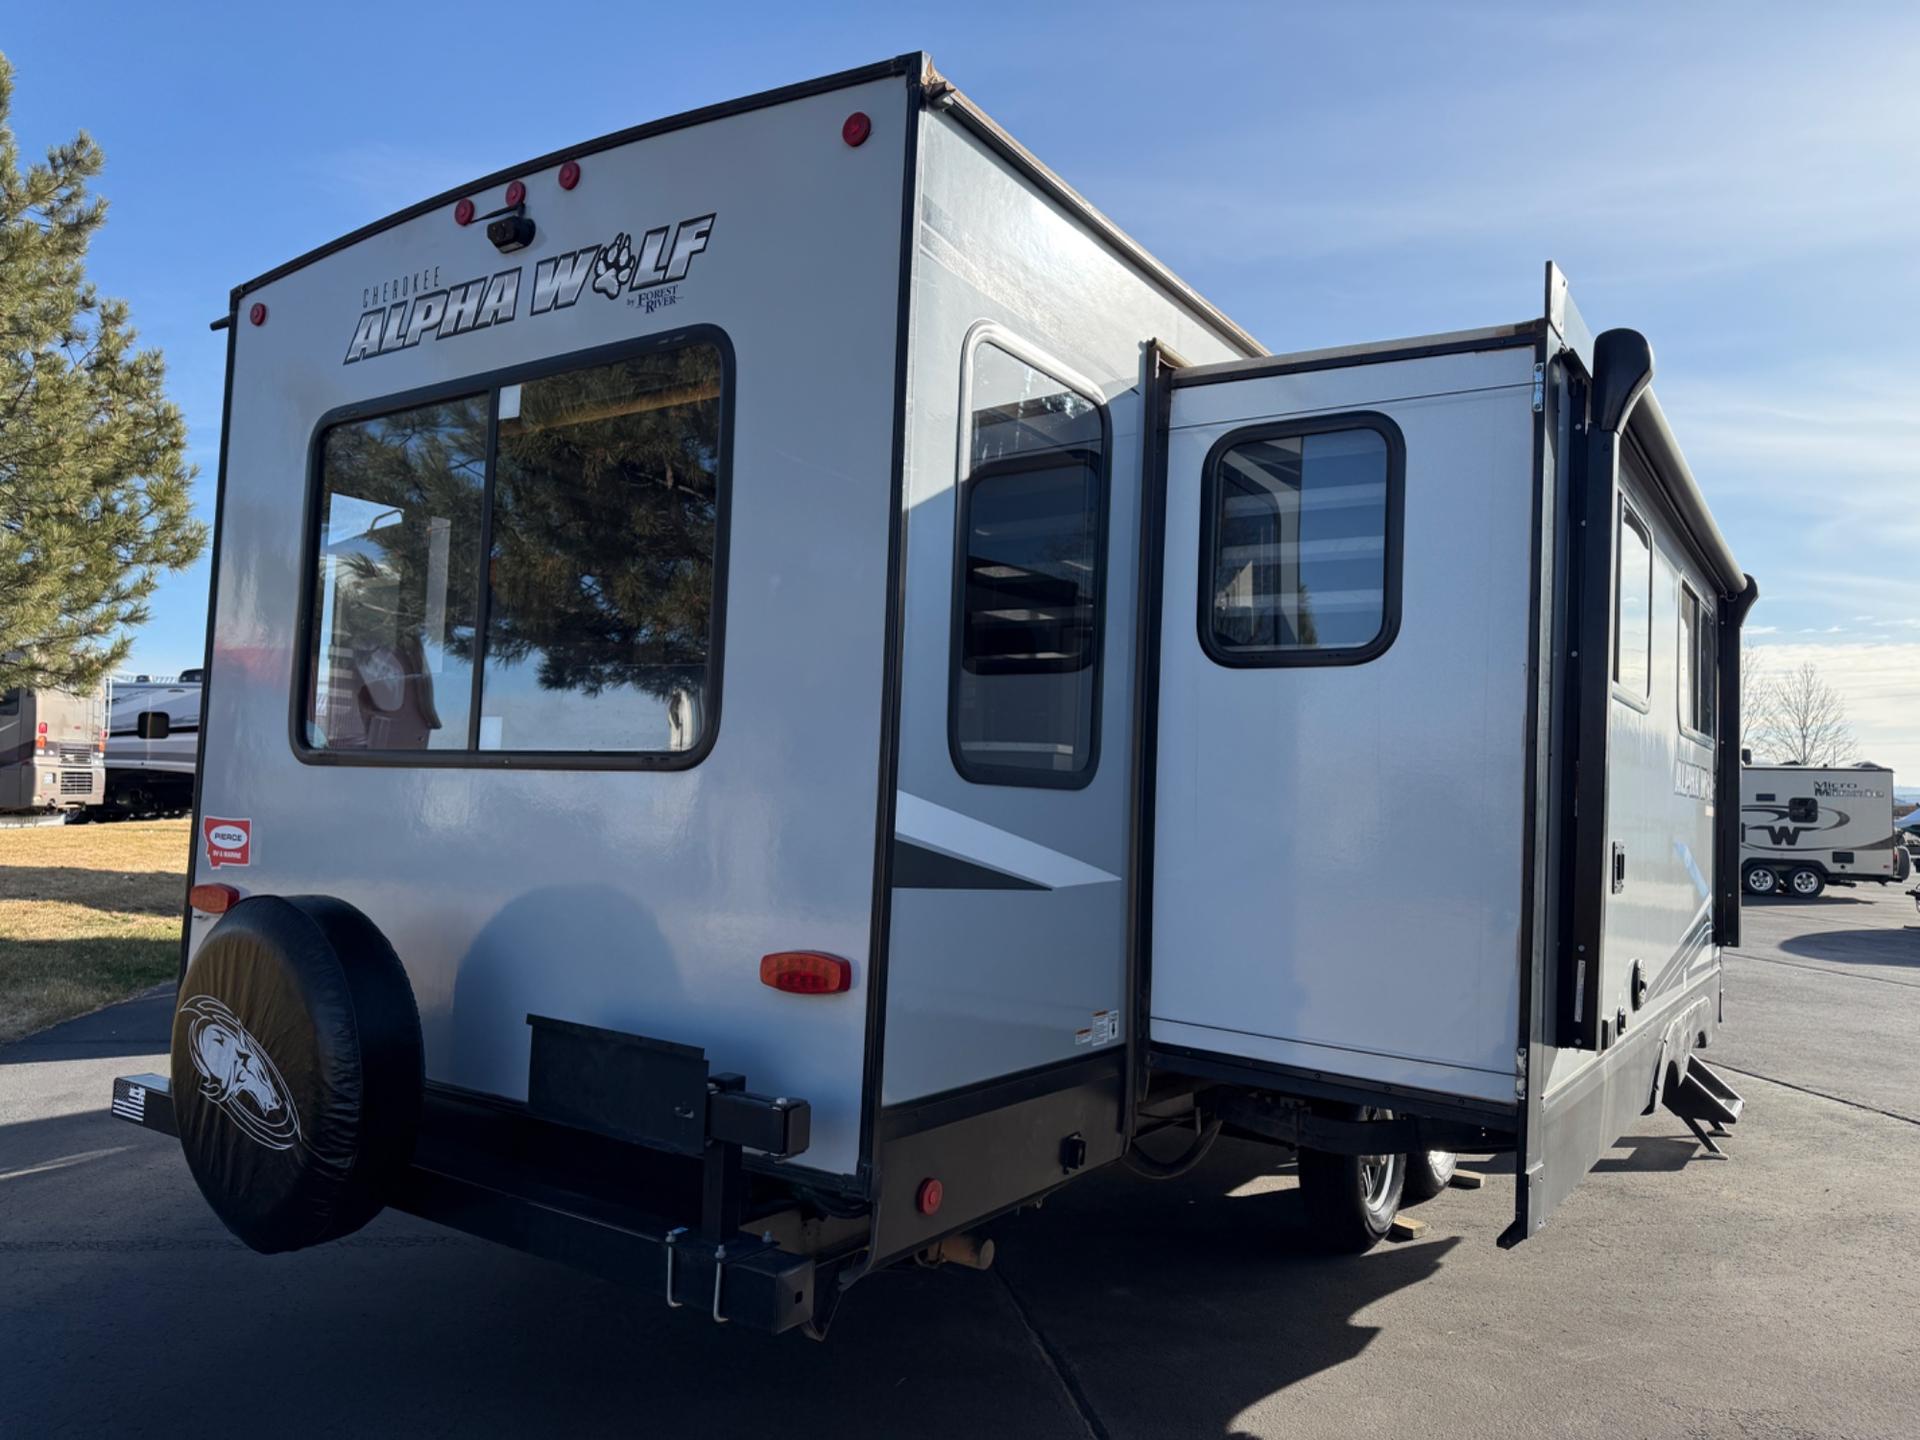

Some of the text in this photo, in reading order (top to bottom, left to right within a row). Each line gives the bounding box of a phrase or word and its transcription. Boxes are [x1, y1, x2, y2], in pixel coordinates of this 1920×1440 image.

[362, 265, 440, 309] CHEROKEE
[638, 284, 679, 308] FOREST
[343, 266, 522, 365] ALPHA
[645, 295, 677, 314] RIVER
[214, 832, 242, 842] PIERCE
